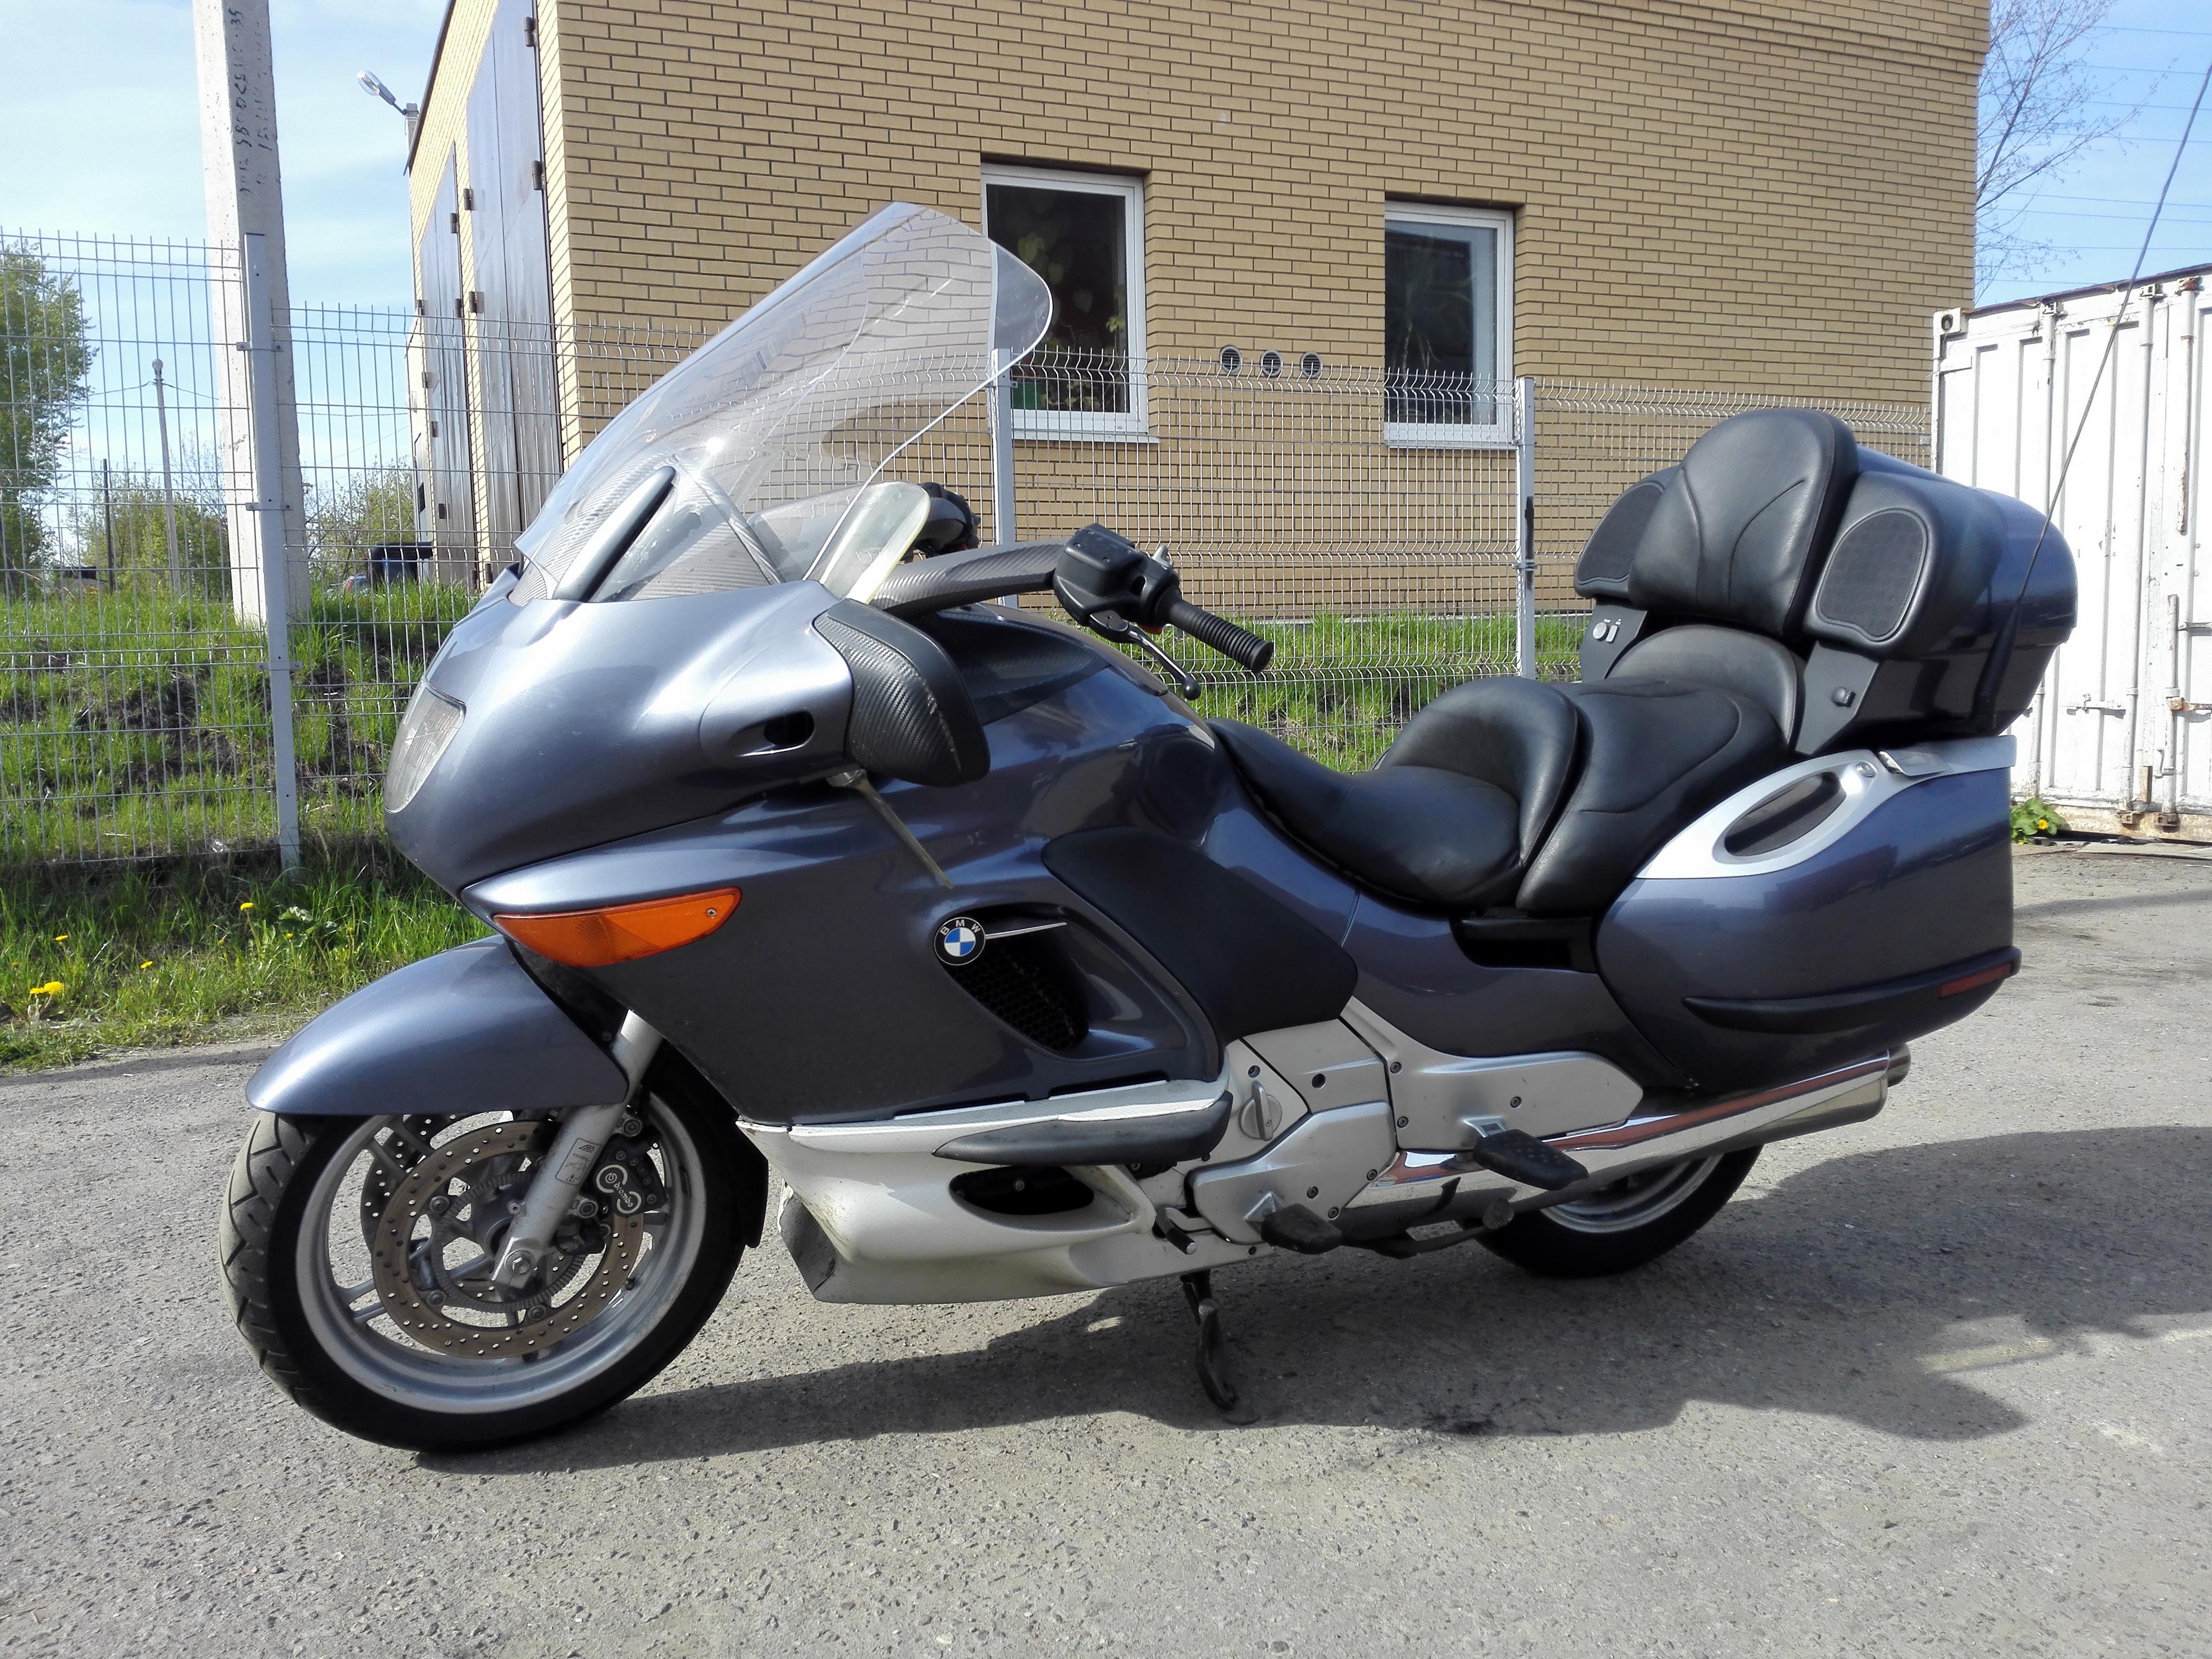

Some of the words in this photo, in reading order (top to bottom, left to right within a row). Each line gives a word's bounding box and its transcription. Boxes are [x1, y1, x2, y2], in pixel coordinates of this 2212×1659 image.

[940, 919, 981, 936] BMW
[579, 1144, 596, 1152] ABS
[614, 1181, 634, 1207] brembo
